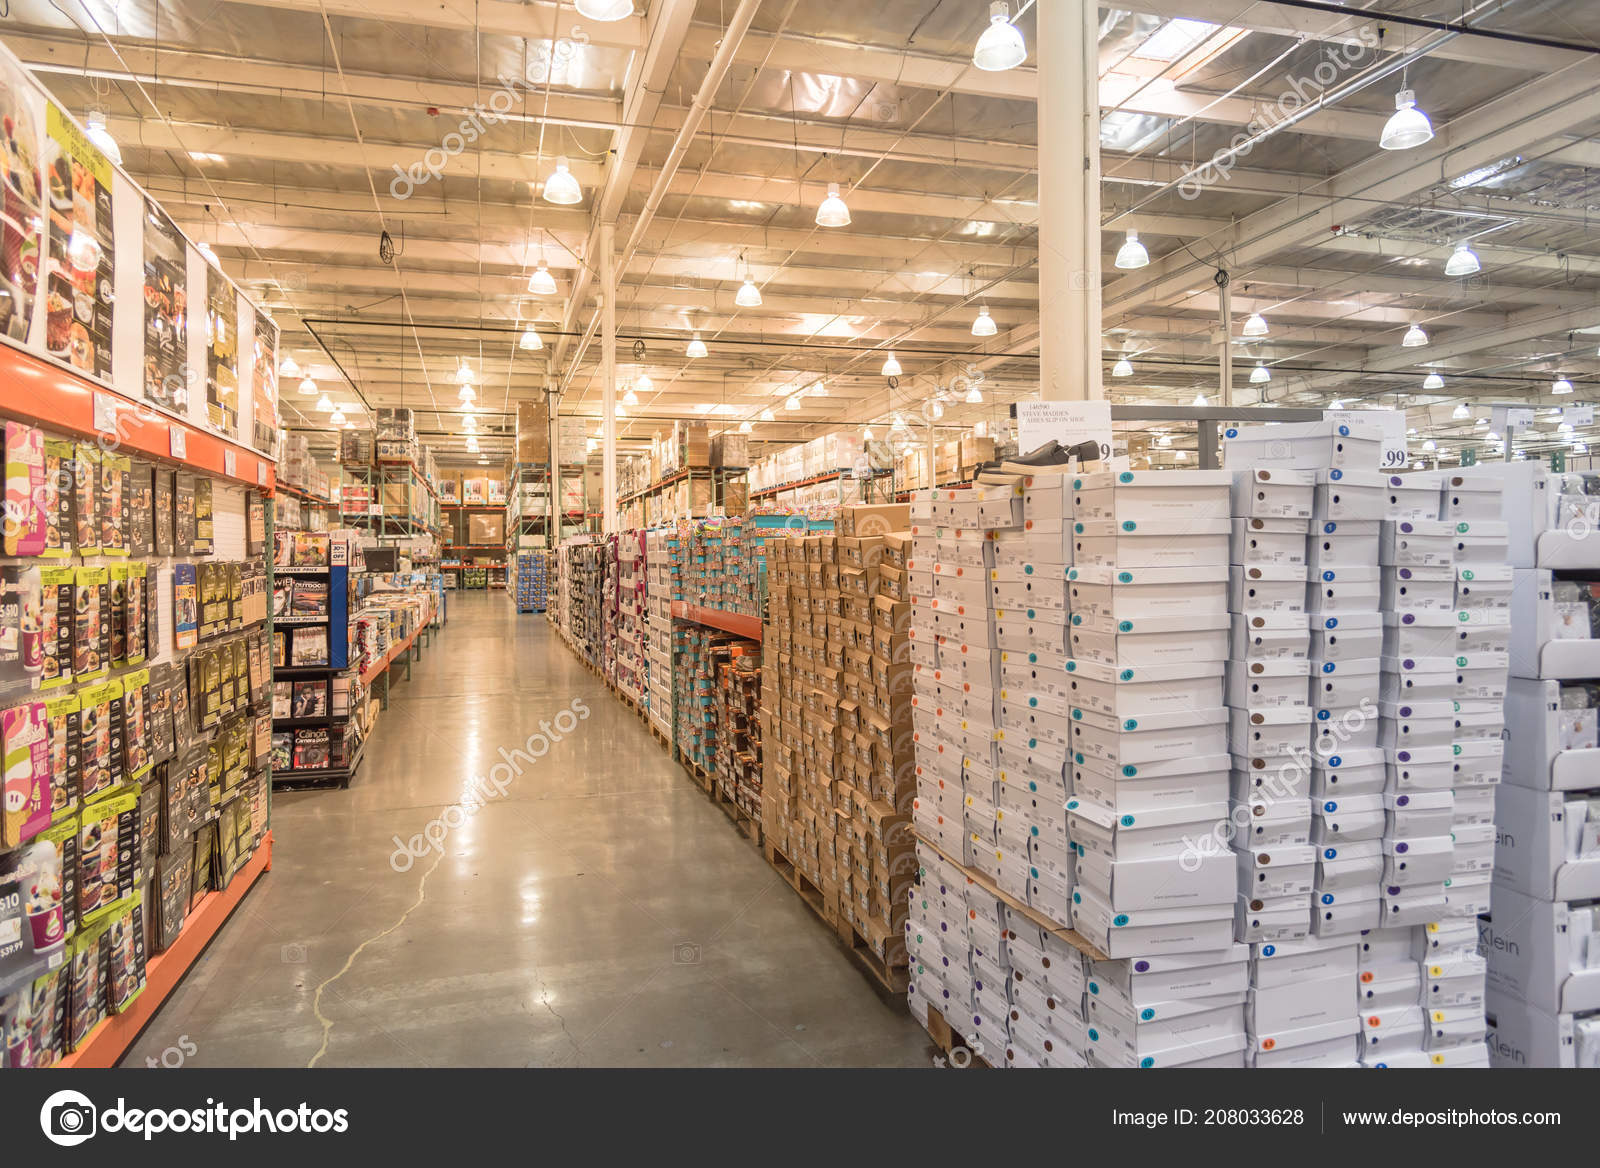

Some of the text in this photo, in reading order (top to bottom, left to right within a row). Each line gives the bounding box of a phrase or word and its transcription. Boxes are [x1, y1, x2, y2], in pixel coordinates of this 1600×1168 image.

[1100, 443, 1111, 460] 9
[1382, 450, 1405, 467] .99
[299, 729, 327, 739] Canon
[0, 940, 24, 958] $39.99
[1479, 925, 1520, 956] Klein
[1485, 1032, 1526, 1064] Klein
